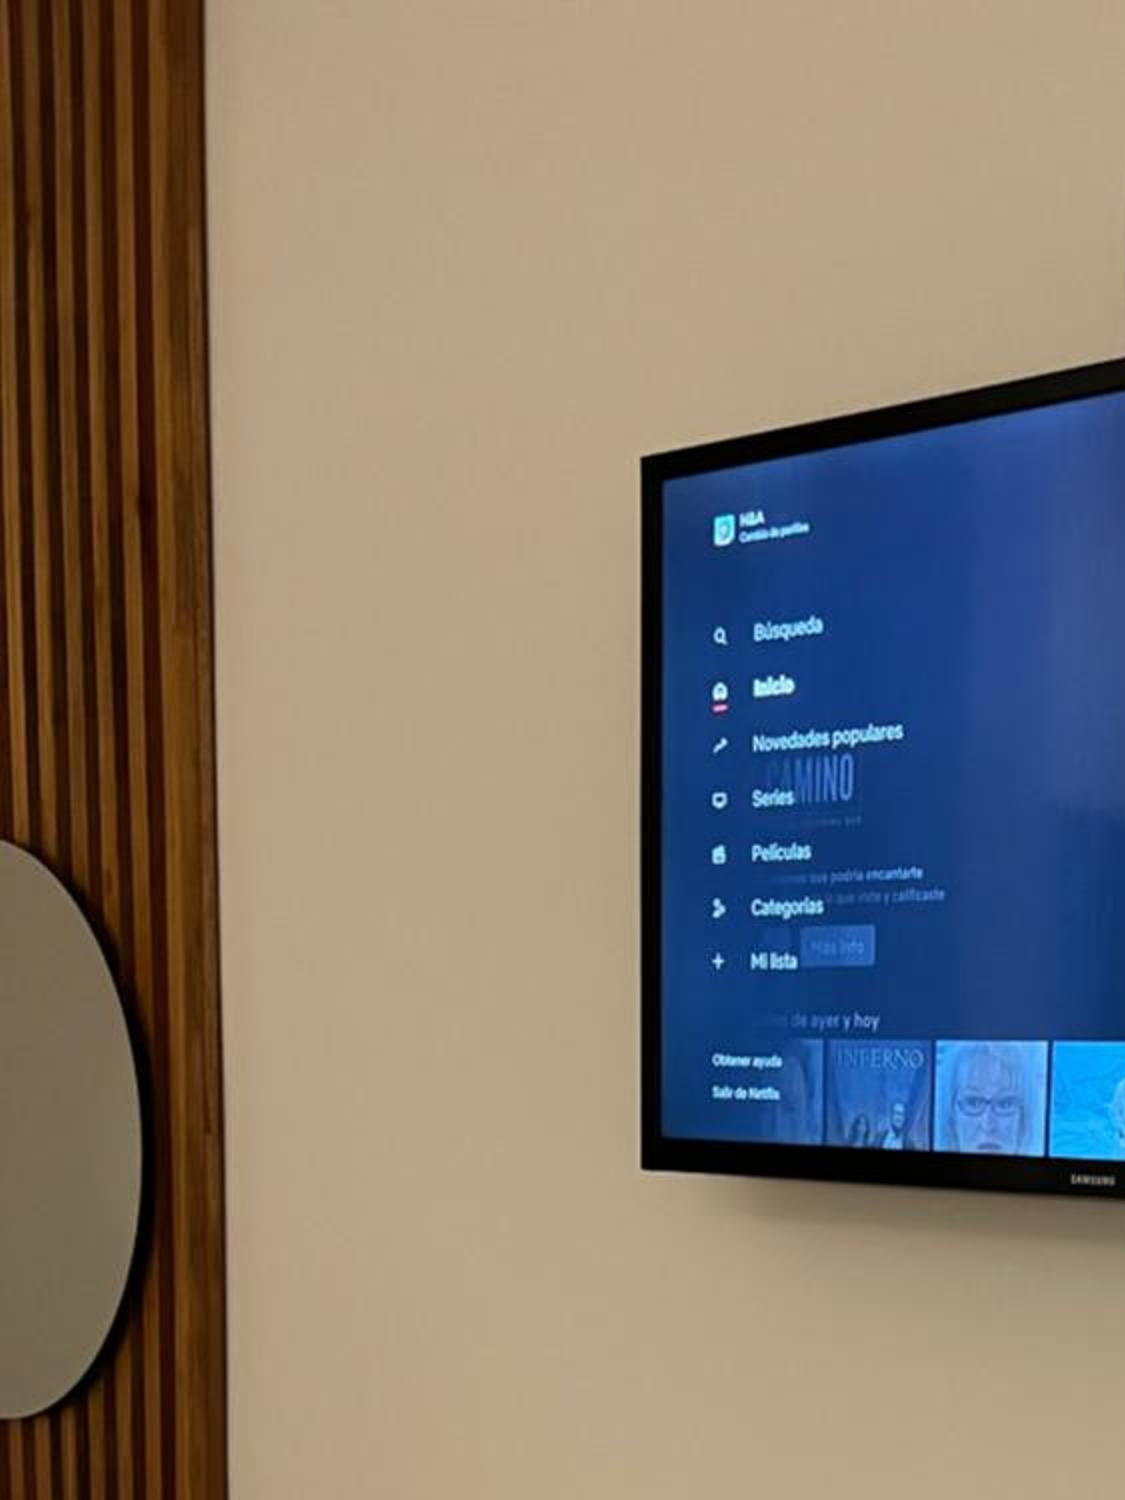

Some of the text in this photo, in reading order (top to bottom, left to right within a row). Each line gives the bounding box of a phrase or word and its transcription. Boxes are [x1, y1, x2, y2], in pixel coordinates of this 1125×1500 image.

[753, 615, 824, 643] Búsqueda
[752, 674, 796, 698] Inicio
[752, 722, 905, 752] Novedades populares
[751, 788, 796, 808] Series
[751, 842, 812, 862] Películas
[751, 896, 824, 920] Categorías
[751, 951, 799, 971] Mi lista
[852, 1011, 880, 1032] hoy
[833, 1046, 926, 1071] INFERNO
